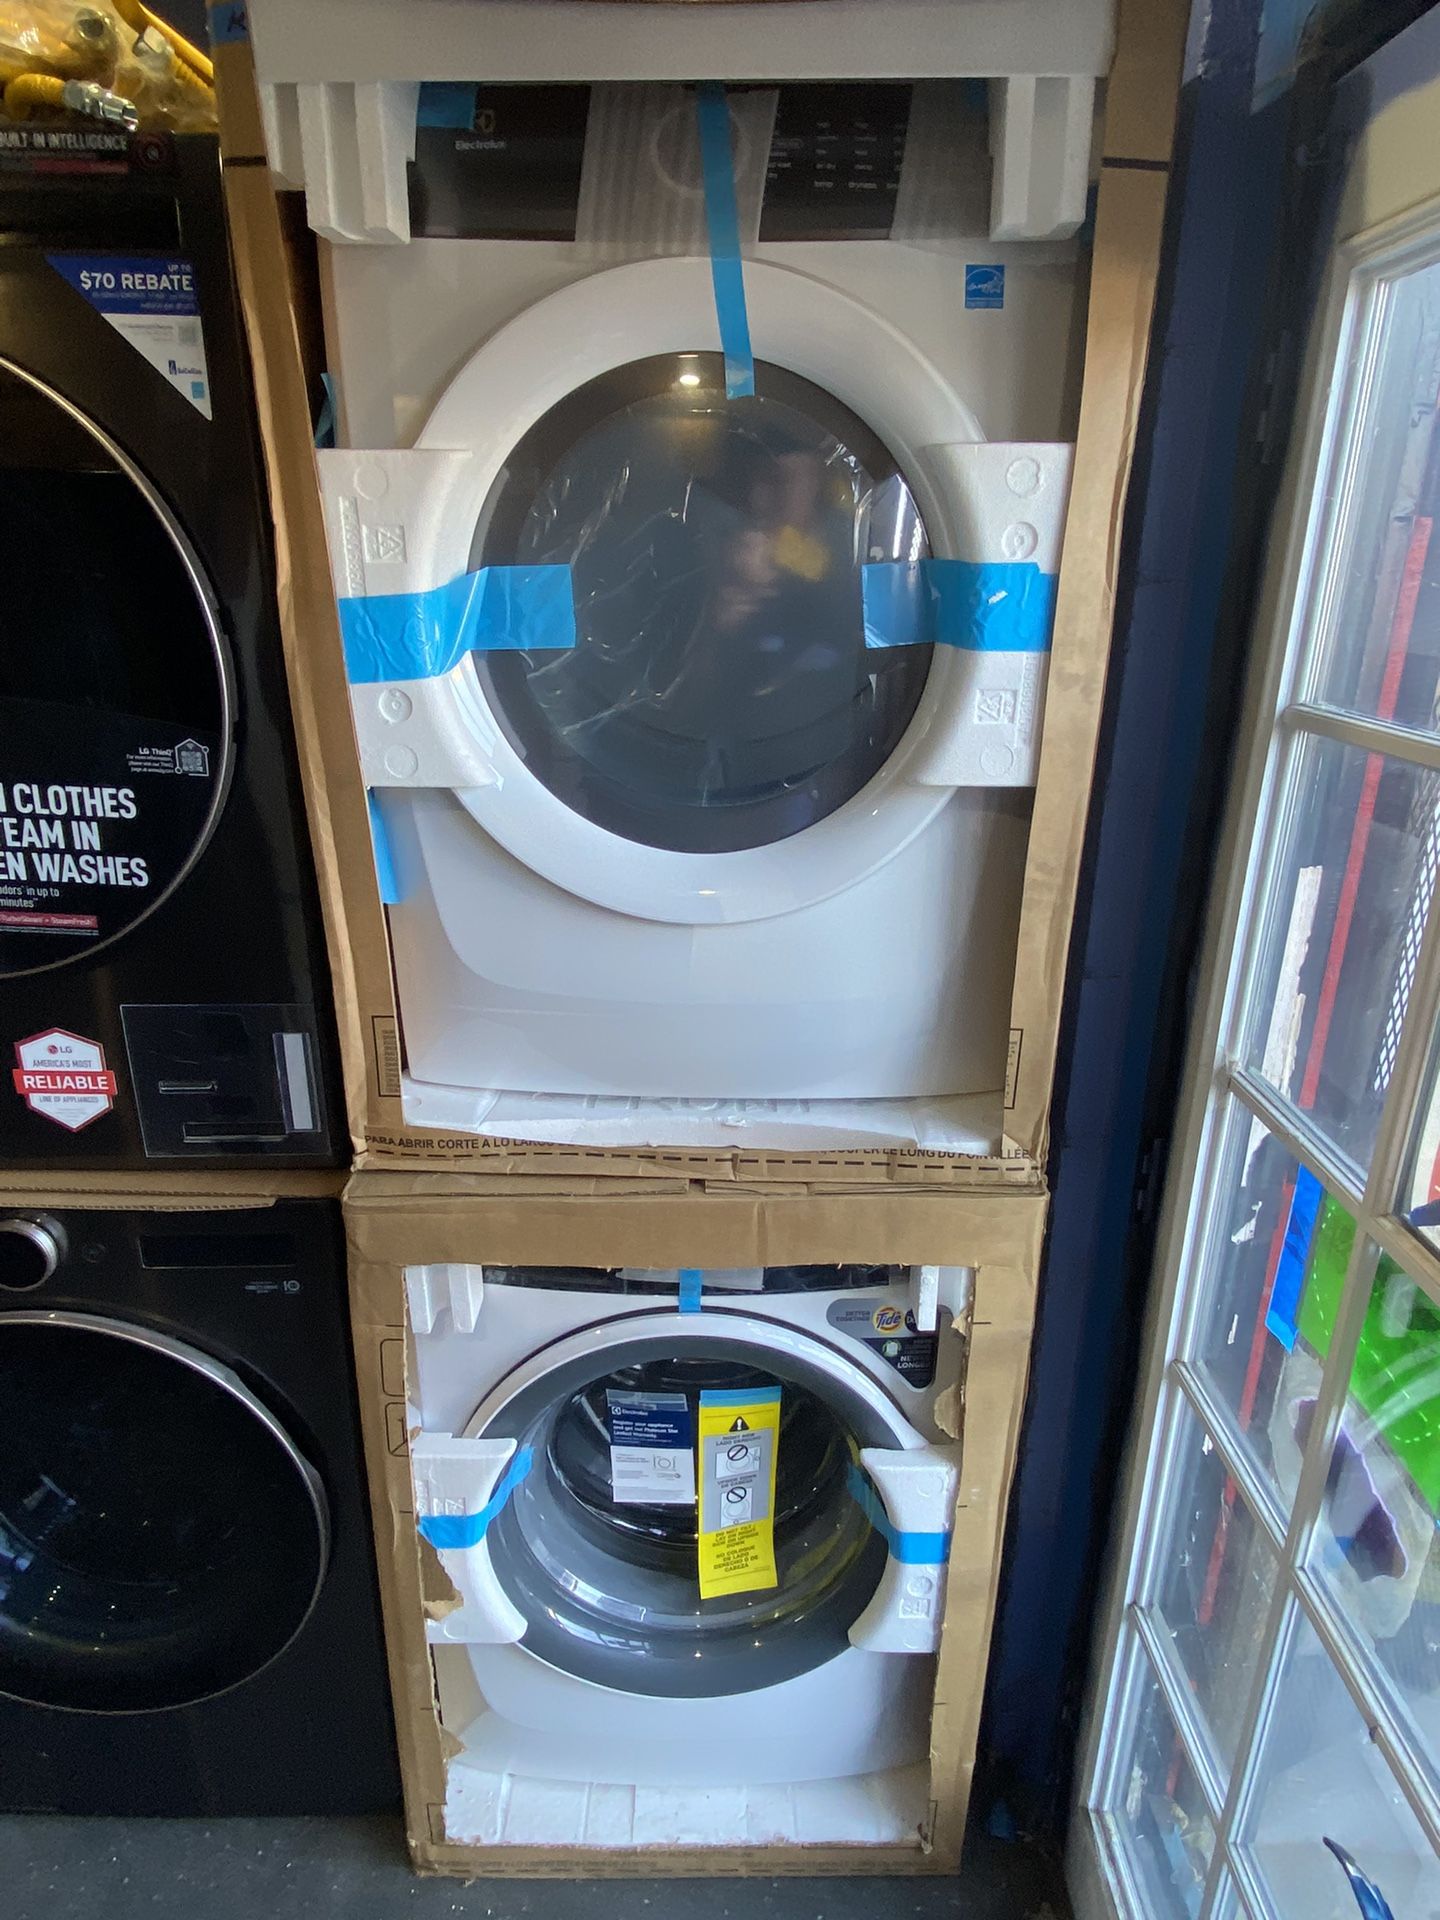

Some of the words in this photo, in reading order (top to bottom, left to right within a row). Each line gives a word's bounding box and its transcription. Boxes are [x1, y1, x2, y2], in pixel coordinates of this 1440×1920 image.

[48, 132, 128, 150] INTELLIGENCE
[455, 140, 505, 150] Electrolux
[80, 270, 115, 290] $70
[121, 273, 193, 291] REBATE
[139, 747, 150, 755] LG
[13, 783, 137, 819] CLOTHES
[0, 817, 66, 849] EAM
[71, 820, 102, 851] IN
[32, 852, 149, 887] WASHES
[26, 886, 36, 896] in
[37, 887, 48, 898] up
[50, 888, 60, 897] to
[60, 1046, 73, 1054] LG
[33, 1060, 71, 1068] AMERICA'S
[73, 1060, 92, 1068] MOST
[23, 1075, 109, 1090] RELIABLE
[364, 1135, 397, 1147] PARA
[398, 1138, 434, 1149] ABRIR
[437, 1139, 479, 1150] CORTE
[481, 1139, 491, 1149] A
[493, 1137, 510, 1147] LO
[900, 1149, 935, 1158] LONG
[877, 1310, 901, 1329] Tide
